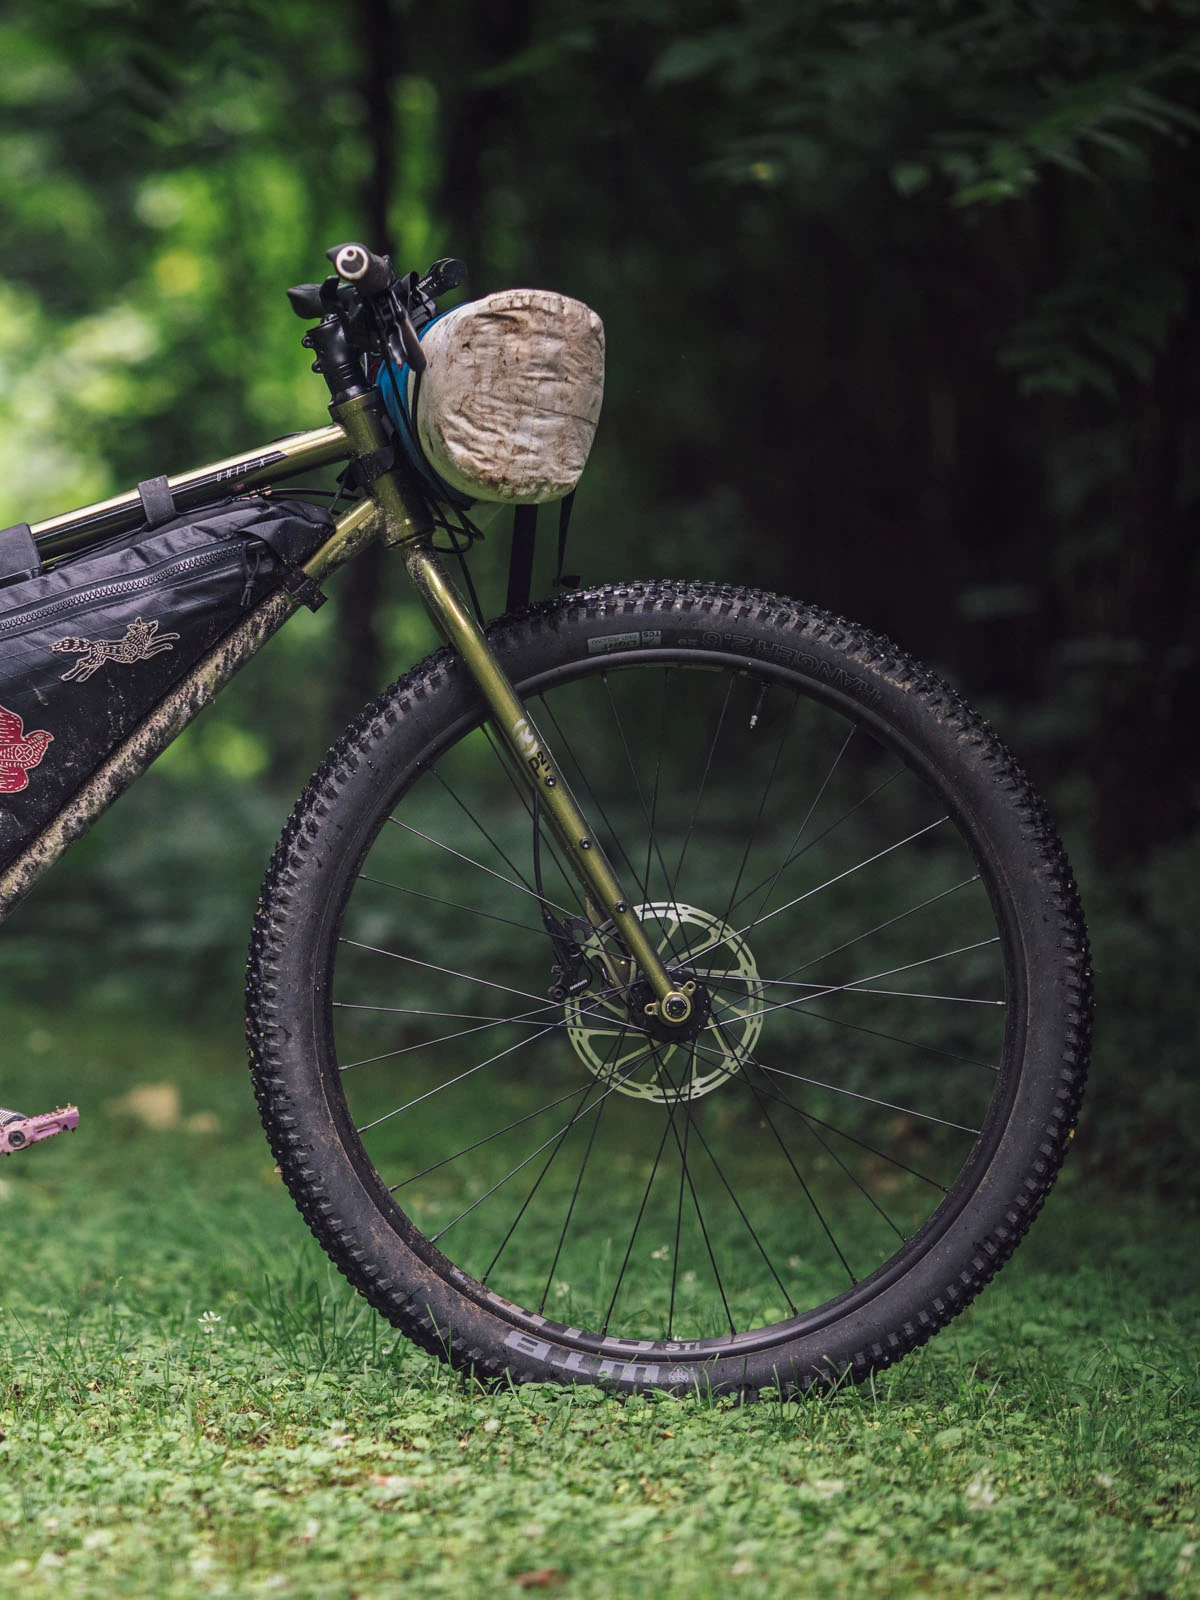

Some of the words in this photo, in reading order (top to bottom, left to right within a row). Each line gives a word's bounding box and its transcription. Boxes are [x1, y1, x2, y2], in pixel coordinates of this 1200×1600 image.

[216, 464, 250, 481] UNIT
[757, 640, 882, 706] RANGER
[504, 1330, 660, 1384] WTB
